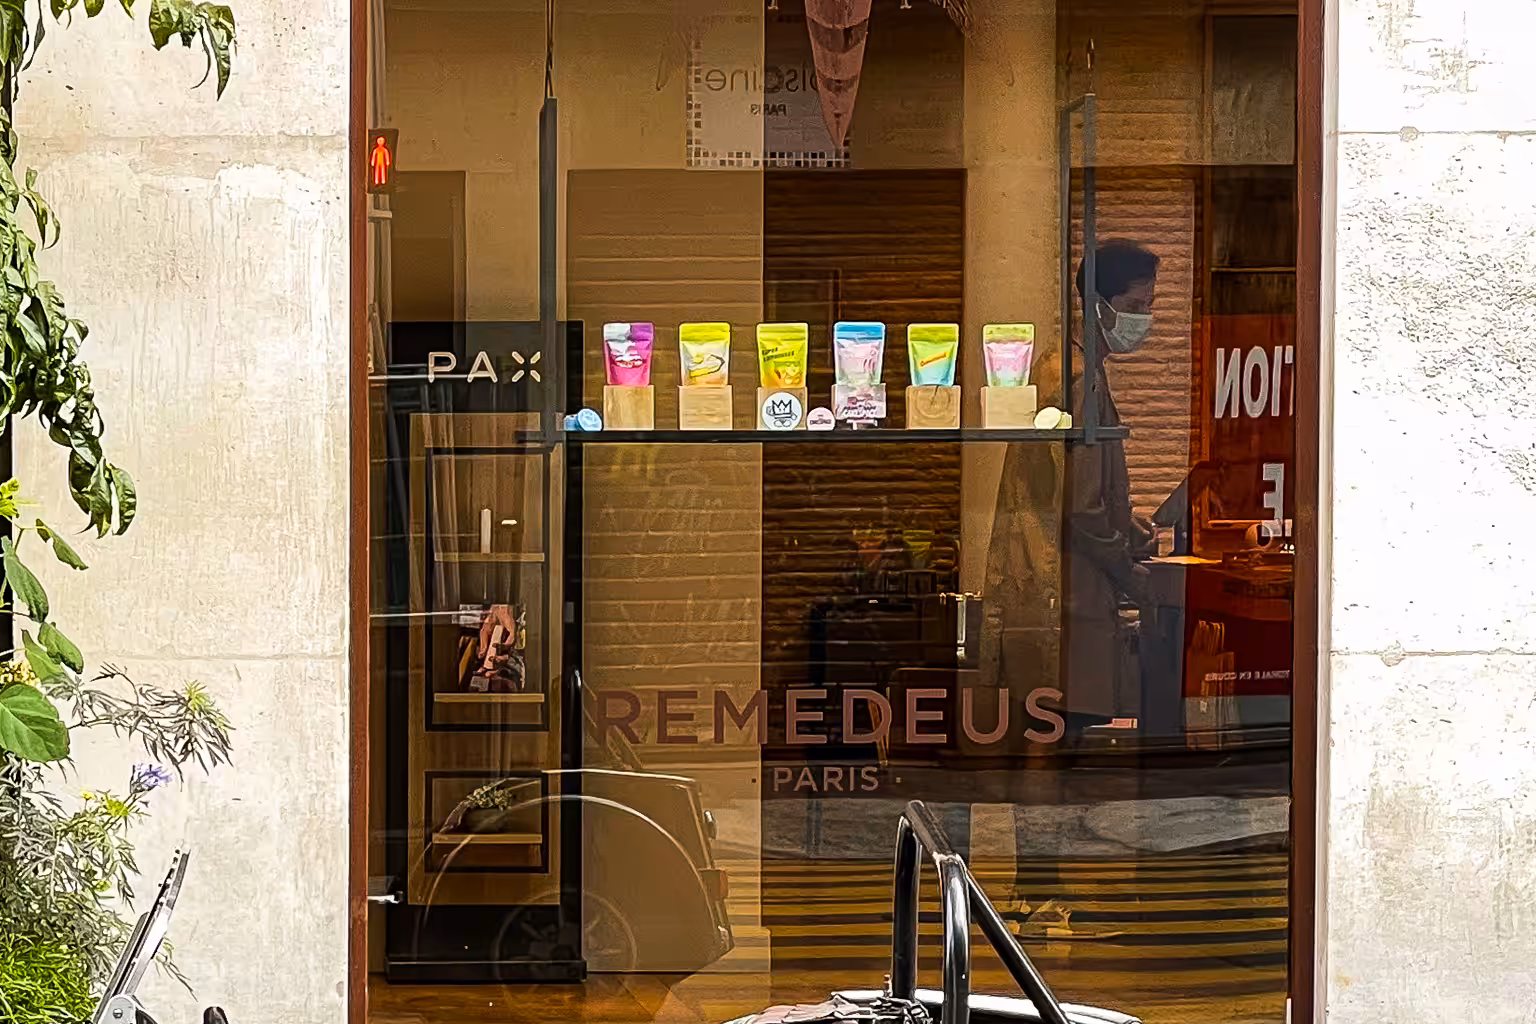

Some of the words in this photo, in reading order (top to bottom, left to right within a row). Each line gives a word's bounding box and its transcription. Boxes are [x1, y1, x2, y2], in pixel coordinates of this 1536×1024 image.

[427, 350, 541, 383] PAX
[596, 686, 1066, 745] REMEDEUS
[772, 765, 881, 792] PARIS
